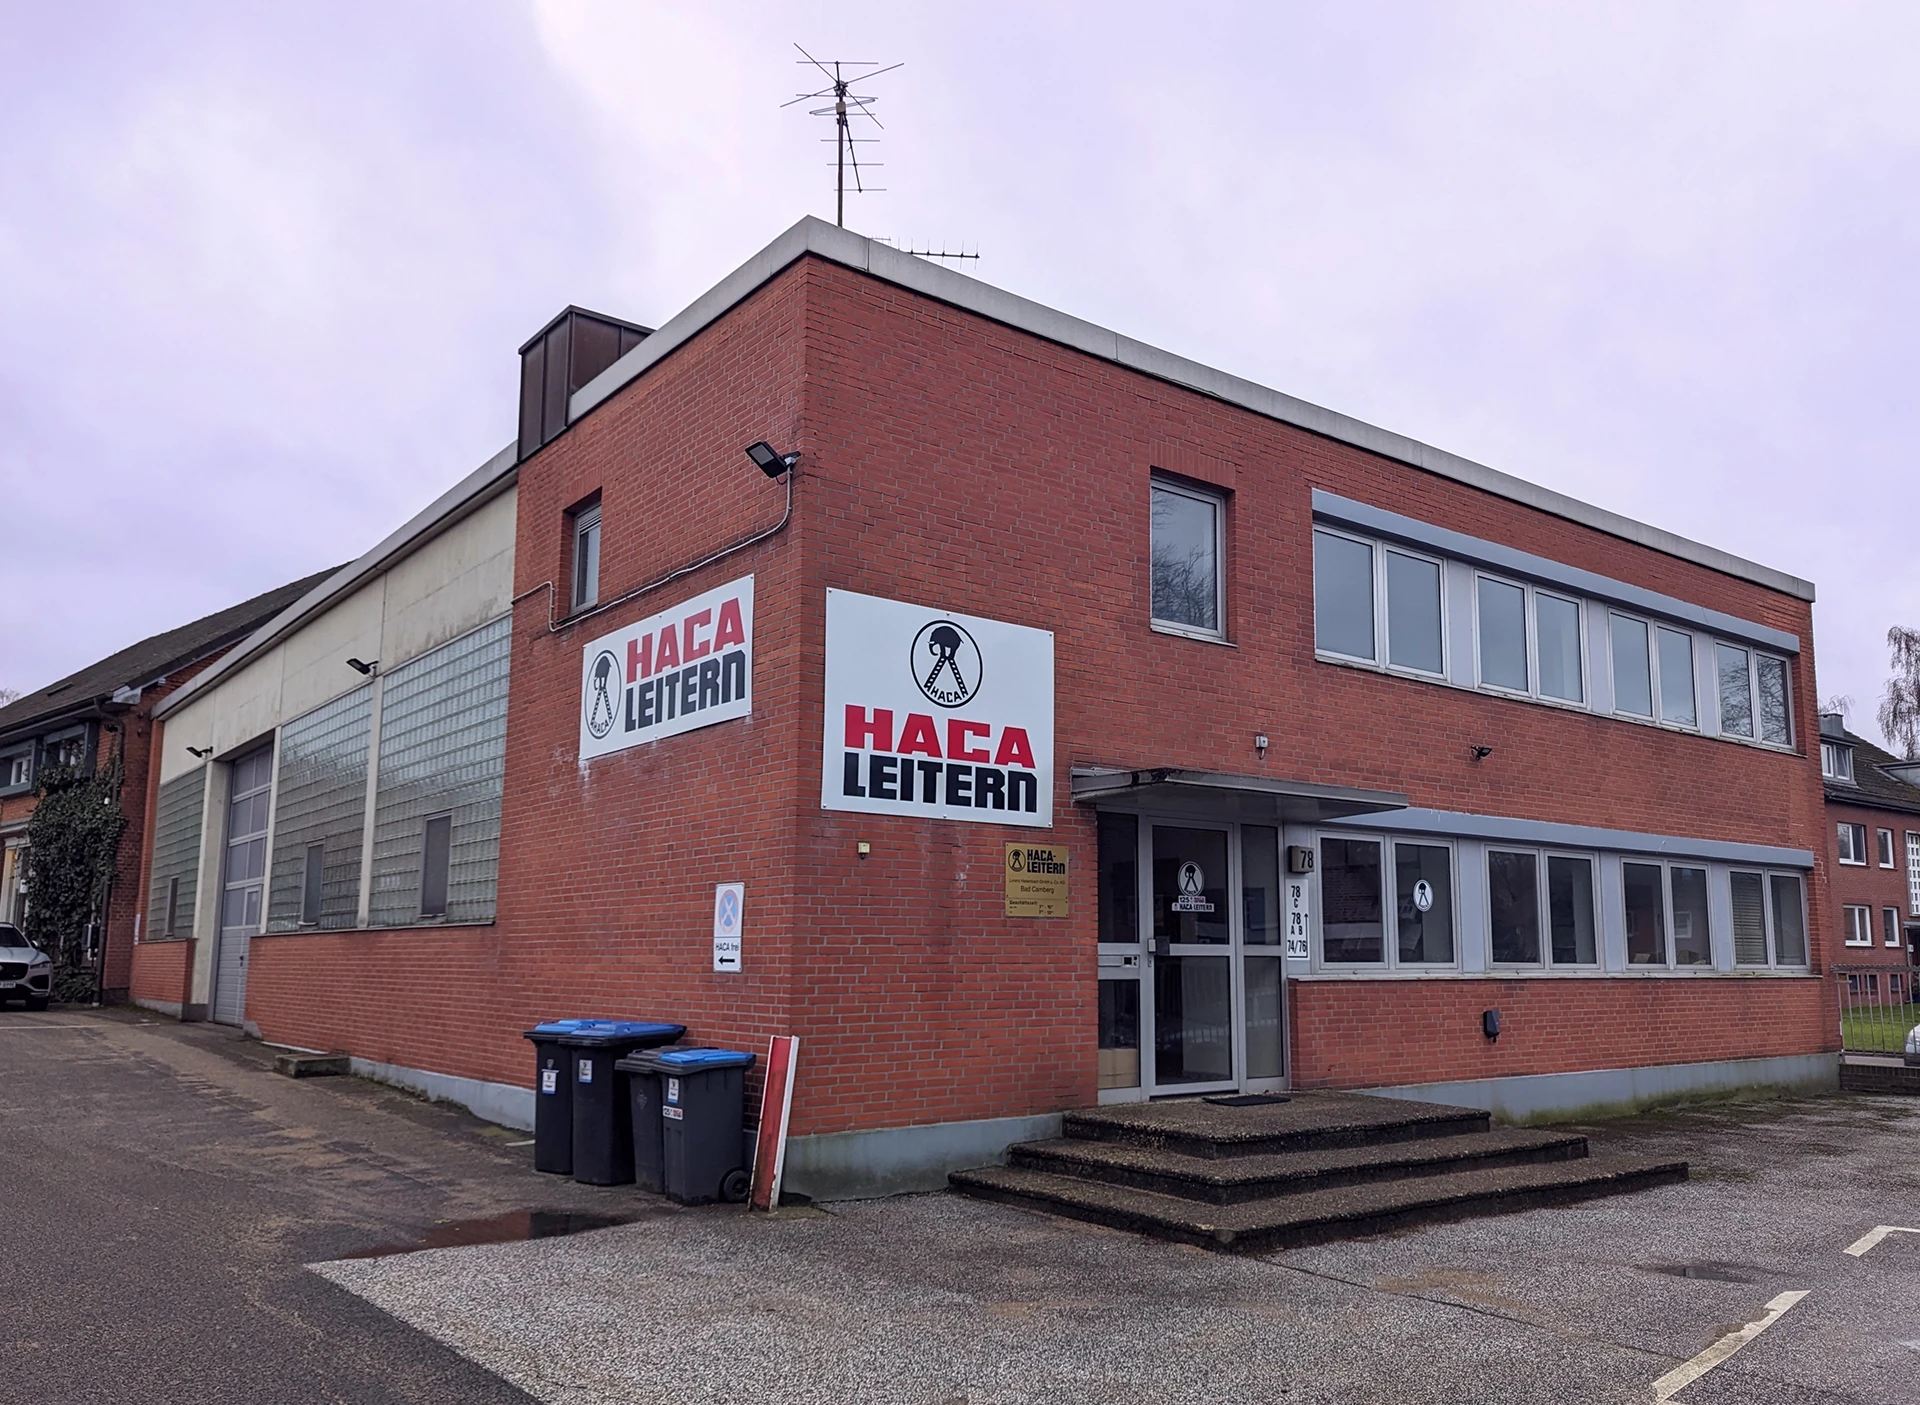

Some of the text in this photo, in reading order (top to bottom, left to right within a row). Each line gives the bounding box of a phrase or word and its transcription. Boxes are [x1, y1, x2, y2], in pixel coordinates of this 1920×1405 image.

[626, 597, 745, 684] HACA
[624, 650, 746, 733] LEITERN
[931, 686, 961, 703] HACA
[844, 704, 1036, 769] HACA
[843, 751, 1037, 813] LEITERN
[1027, 849, 1056, 862] HACA-
[1300, 850, 1314, 869] 78
[1027, 861, 1066, 875] LEITERN
[1291, 885, 1301, 898] 78
[1293, 898, 1299, 908] C
[1291, 912, 1302, 925] 78
[1290, 925, 1303, 935] A B
[715, 943, 730, 951] HACA
[1287, 940, 1307, 954] 74/76
